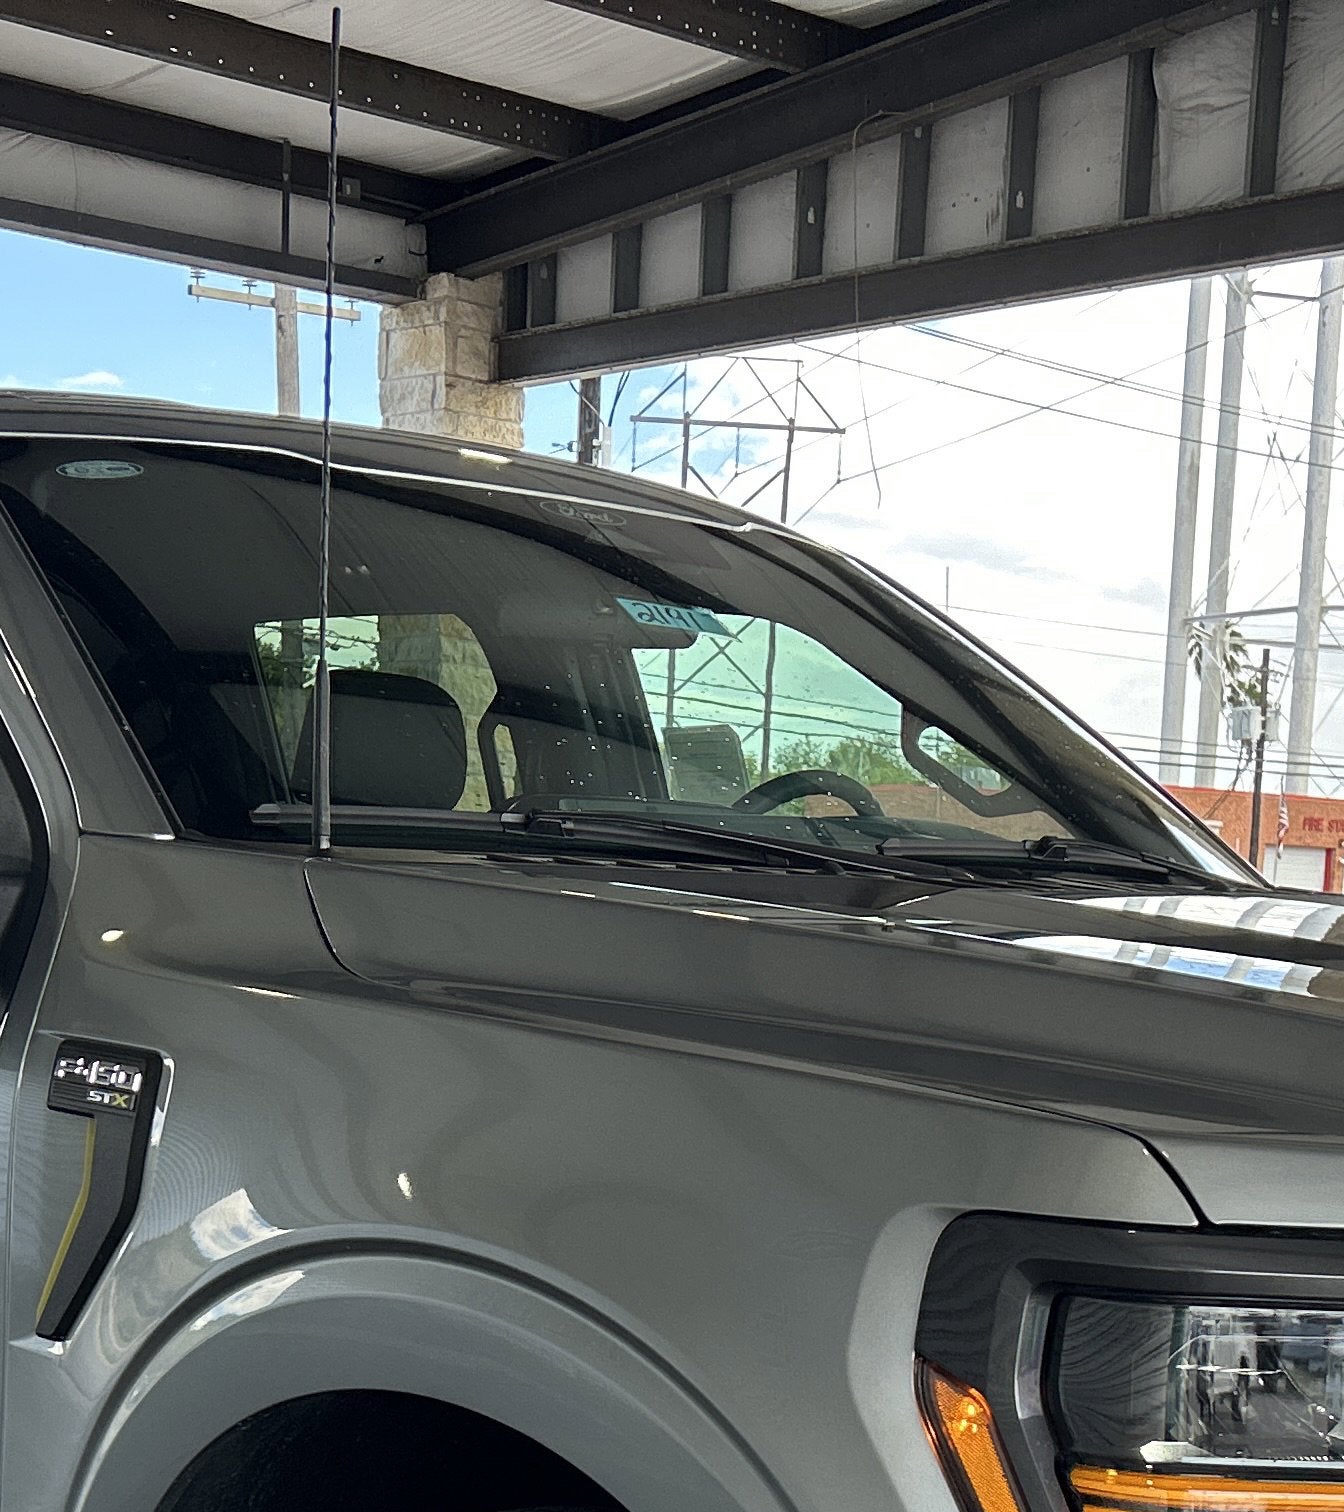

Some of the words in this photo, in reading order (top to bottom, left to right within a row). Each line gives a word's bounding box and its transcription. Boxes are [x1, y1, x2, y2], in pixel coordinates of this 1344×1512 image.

[1302, 816, 1324, 832] FIRE
[54, 1057, 143, 1092] F-150
[86, 1090, 129, 1109] STX
